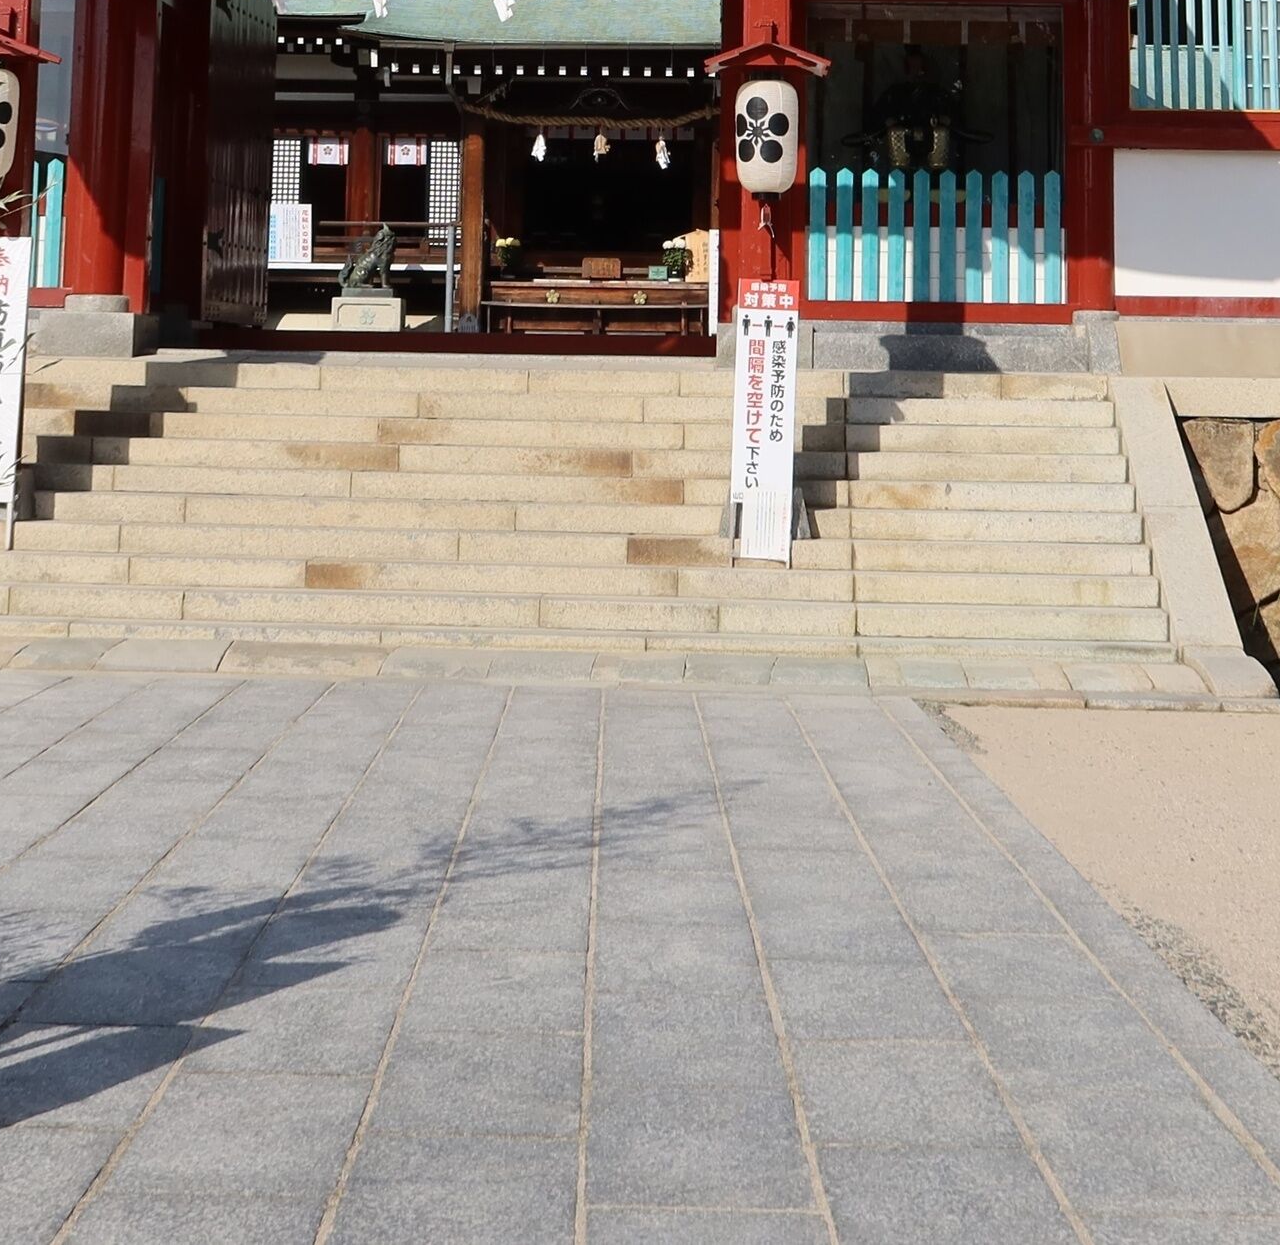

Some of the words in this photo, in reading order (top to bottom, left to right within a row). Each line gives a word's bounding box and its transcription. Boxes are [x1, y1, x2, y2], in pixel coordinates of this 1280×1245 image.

[743, 292, 794, 308] 対策中
[744, 339, 765, 489] 間隔を空けて下さい
[769, 340, 786, 442] 感染予防のため
